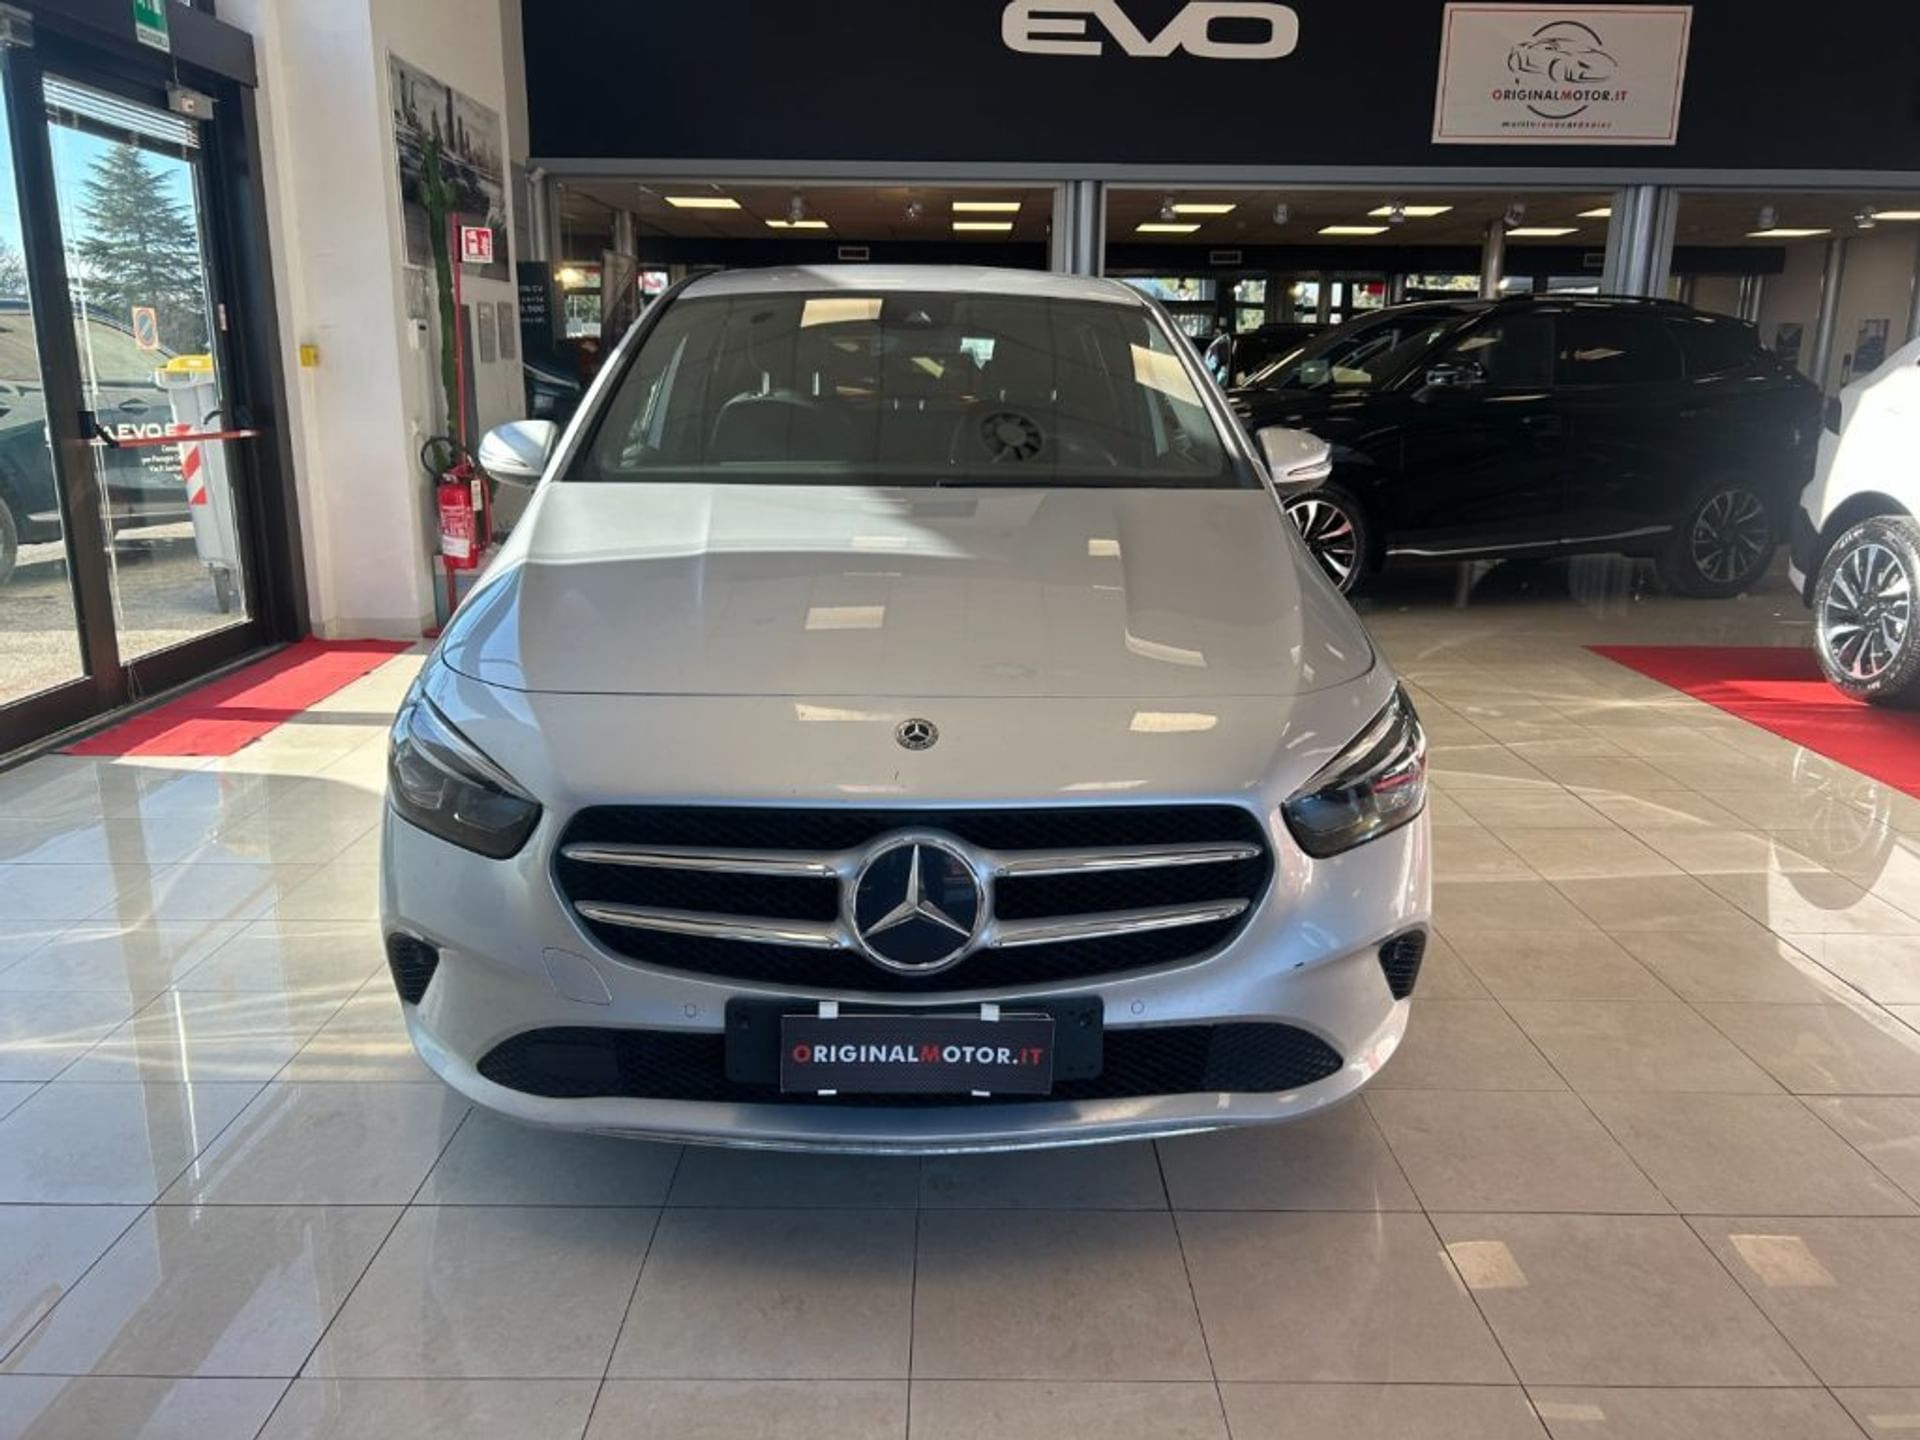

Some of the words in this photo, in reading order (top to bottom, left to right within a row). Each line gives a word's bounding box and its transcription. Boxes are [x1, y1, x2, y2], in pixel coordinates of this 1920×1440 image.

[1002, 0, 1299, 59] EVO
[1491, 89, 1628, 101] ORIGINALMOTOR.IT
[793, 1044, 1043, 1065] ORIGINALMOTOR.IT
